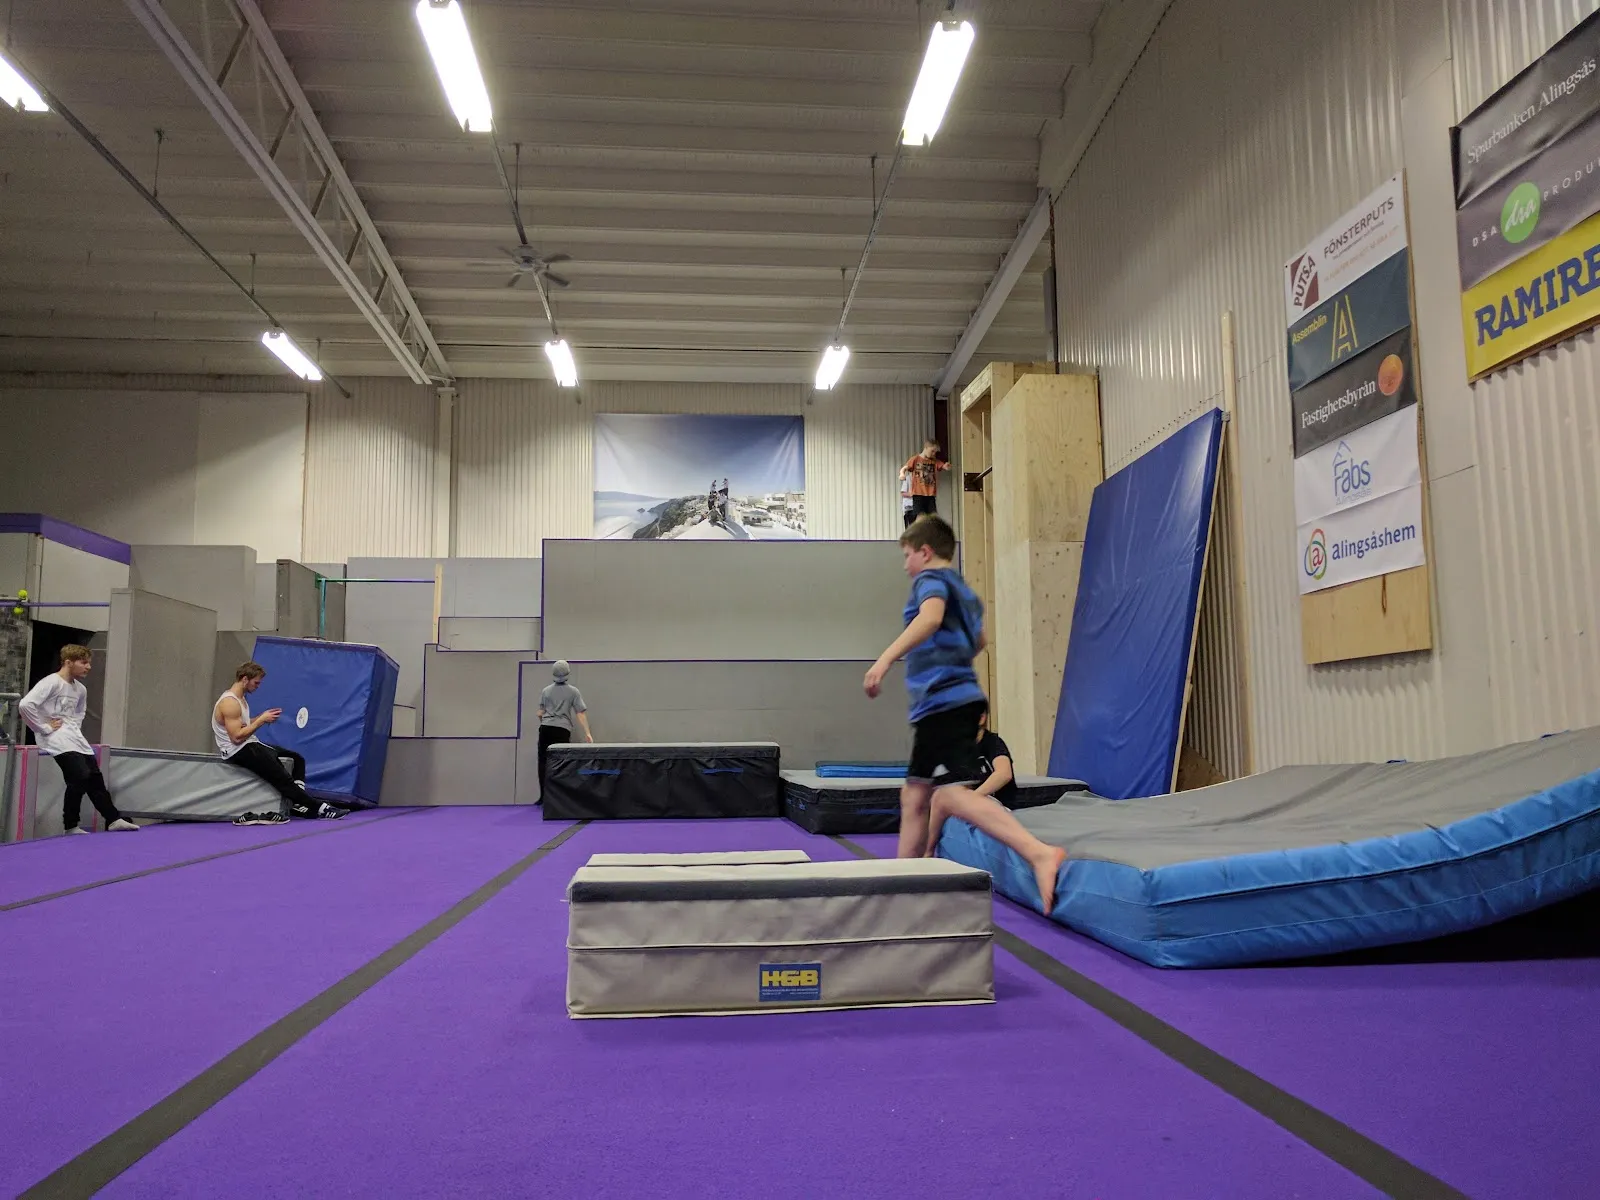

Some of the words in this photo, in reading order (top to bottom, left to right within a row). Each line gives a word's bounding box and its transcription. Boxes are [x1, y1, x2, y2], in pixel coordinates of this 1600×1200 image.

[1467, 104, 1536, 165] Sparbanken
[1538, 57, 1597, 113] Alingsås
[1543, 156, 1600, 201] PRODU
[1324, 196, 1394, 259] FÖNSTERPUTS
[1505, 194, 1537, 233] dsa
[1472, 226, 1498, 248] DSA
[1294, 255, 1316, 307] PUTSA
[1475, 243, 1600, 347] RAMIRE
[1292, 314, 1328, 346] Assemblin
[1301, 379, 1377, 430] Fastighetsbyrån
[1332, 523, 1416, 561] alingsåshem
[761, 969, 819, 987] HGB
